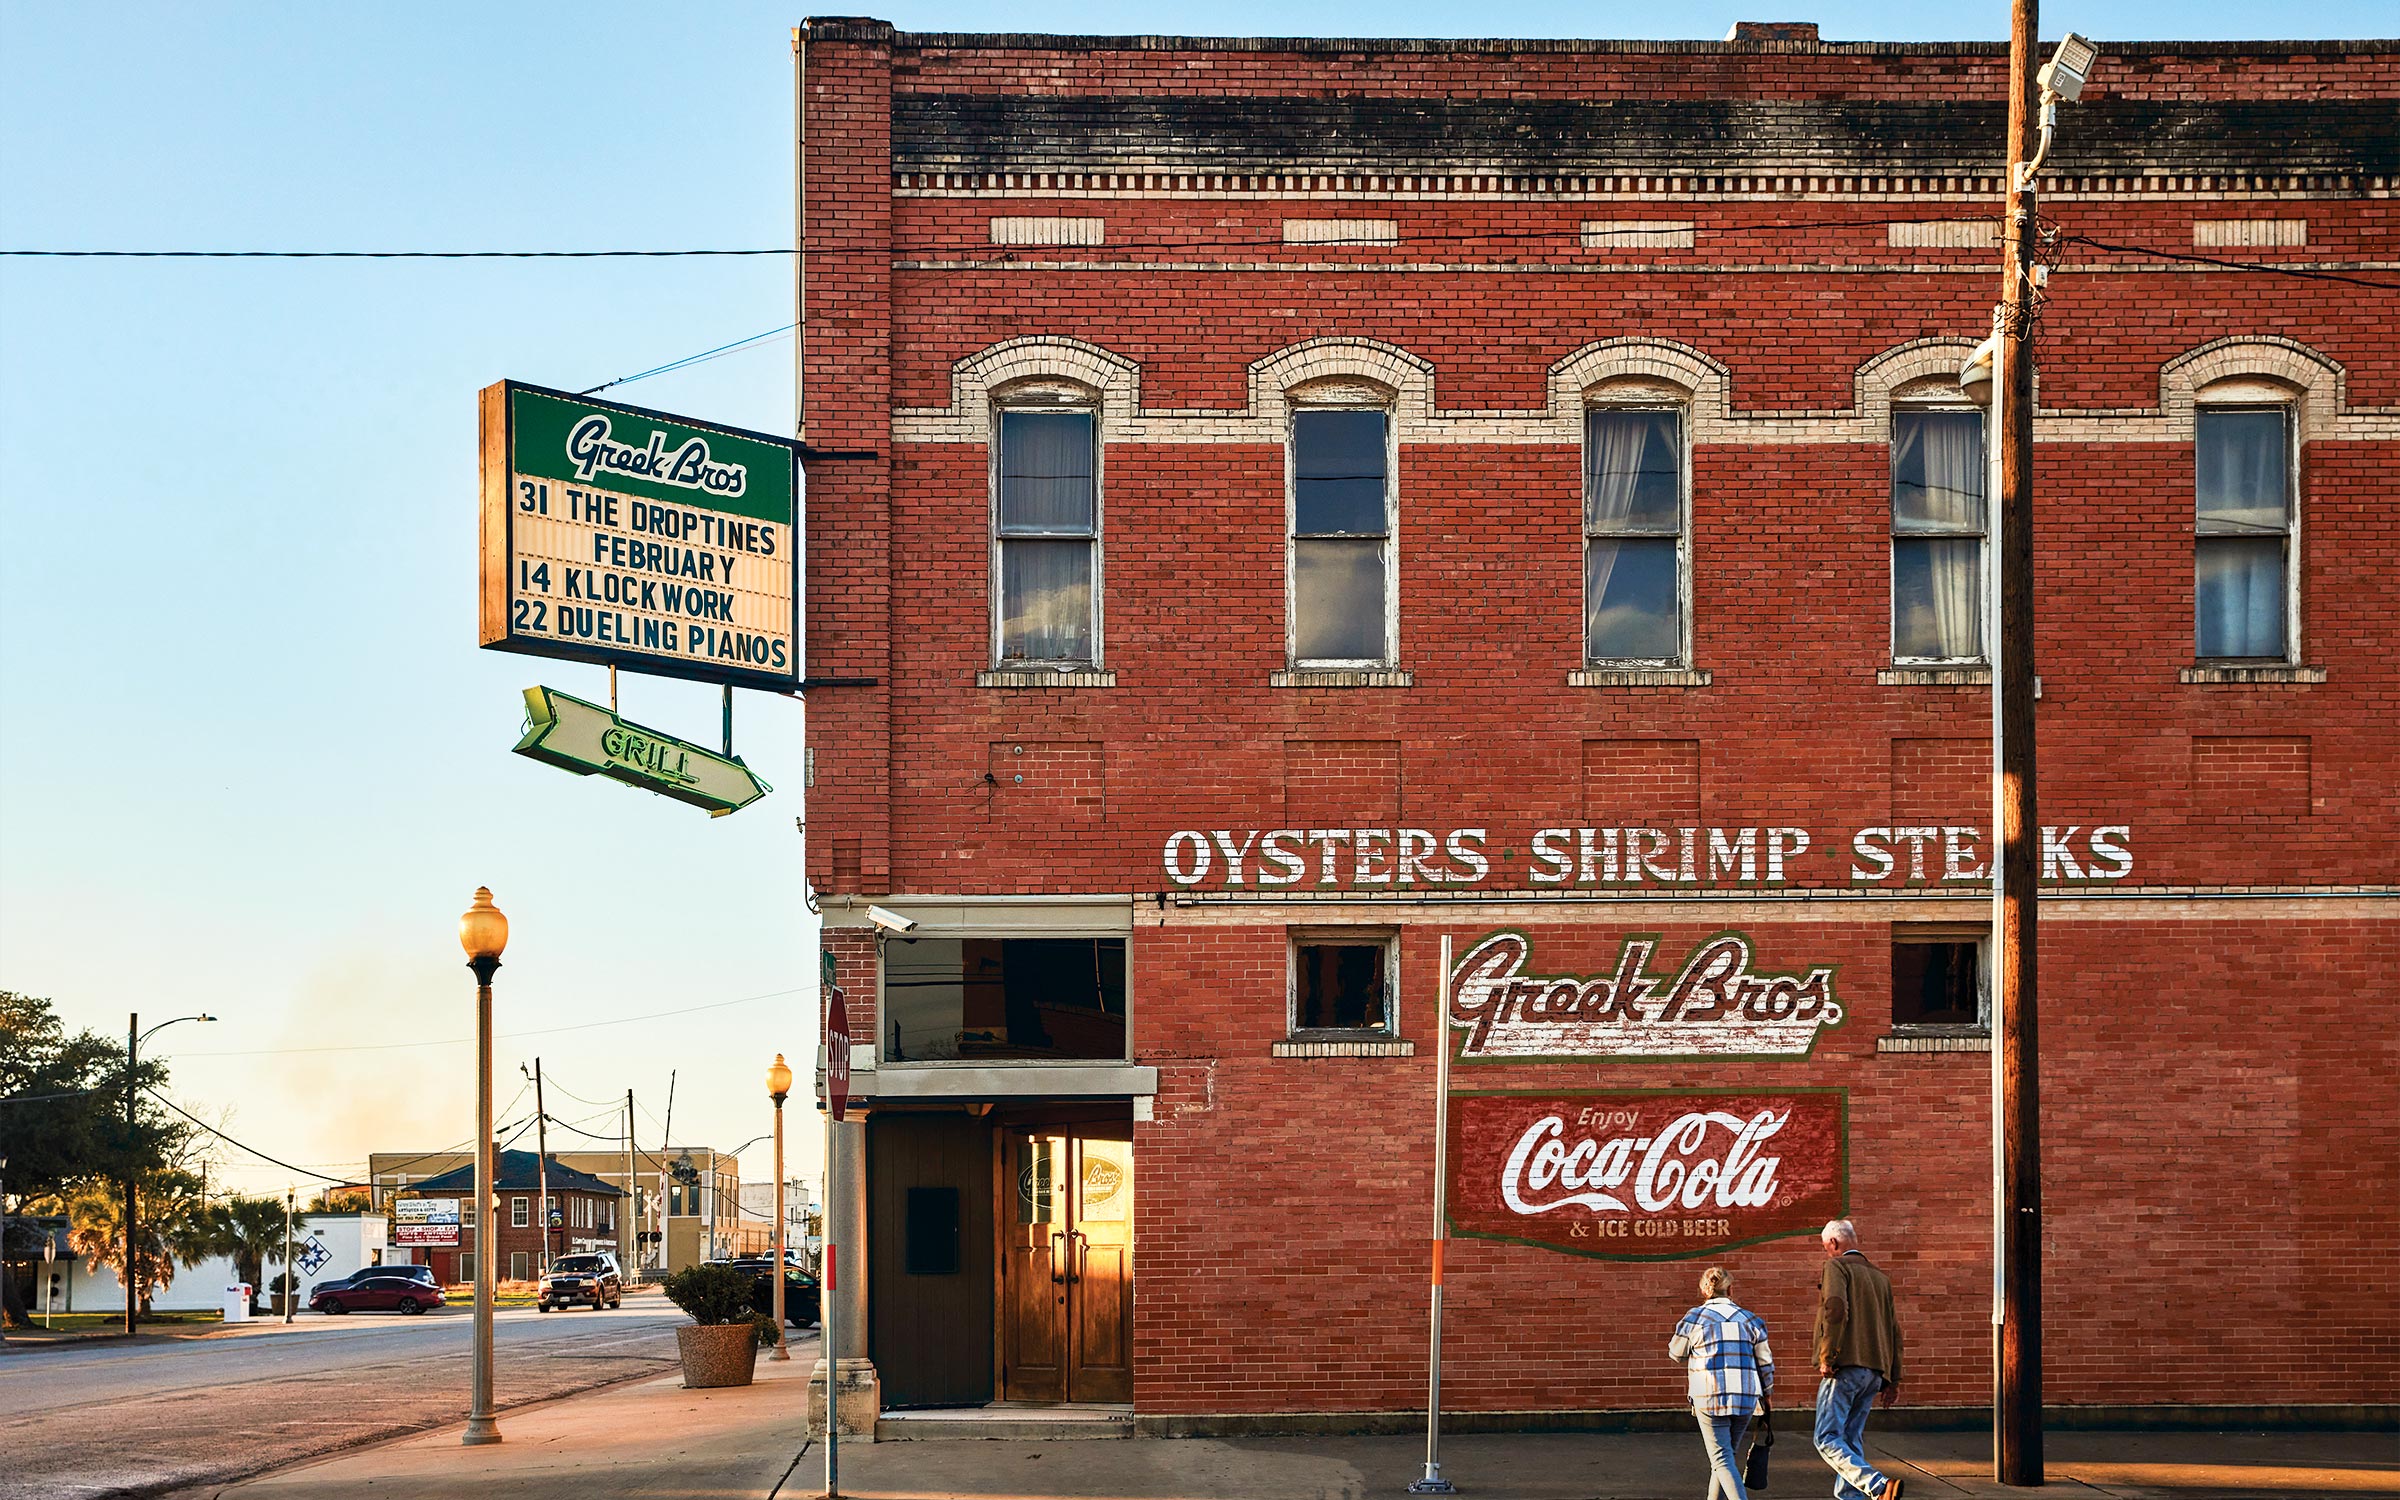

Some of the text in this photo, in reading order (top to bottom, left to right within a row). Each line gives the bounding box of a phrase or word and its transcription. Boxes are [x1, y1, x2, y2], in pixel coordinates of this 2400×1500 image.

[568, 416, 745, 496] Greek Bros
[519, 481, 775, 555] 31 THE DROPTINES
[521, 559, 551, 593] 14
[594, 532, 736, 585] FEBRUARY
[514, 599, 786, 668] 22 DUELING PIANOS
[601, 728, 700, 784] GRILL
[1163, 825, 2135, 886] OYSTERS SHRIMP STEKS
[1450, 934, 1661, 1053] Greek
[828, 1028, 849, 1081] STOP
[1577, 1107, 1639, 1130] Enjoy
[1502, 1108, 1791, 1215] Coca-Cola
[1569, 1218, 1731, 1238] & ICE COLD BEER
